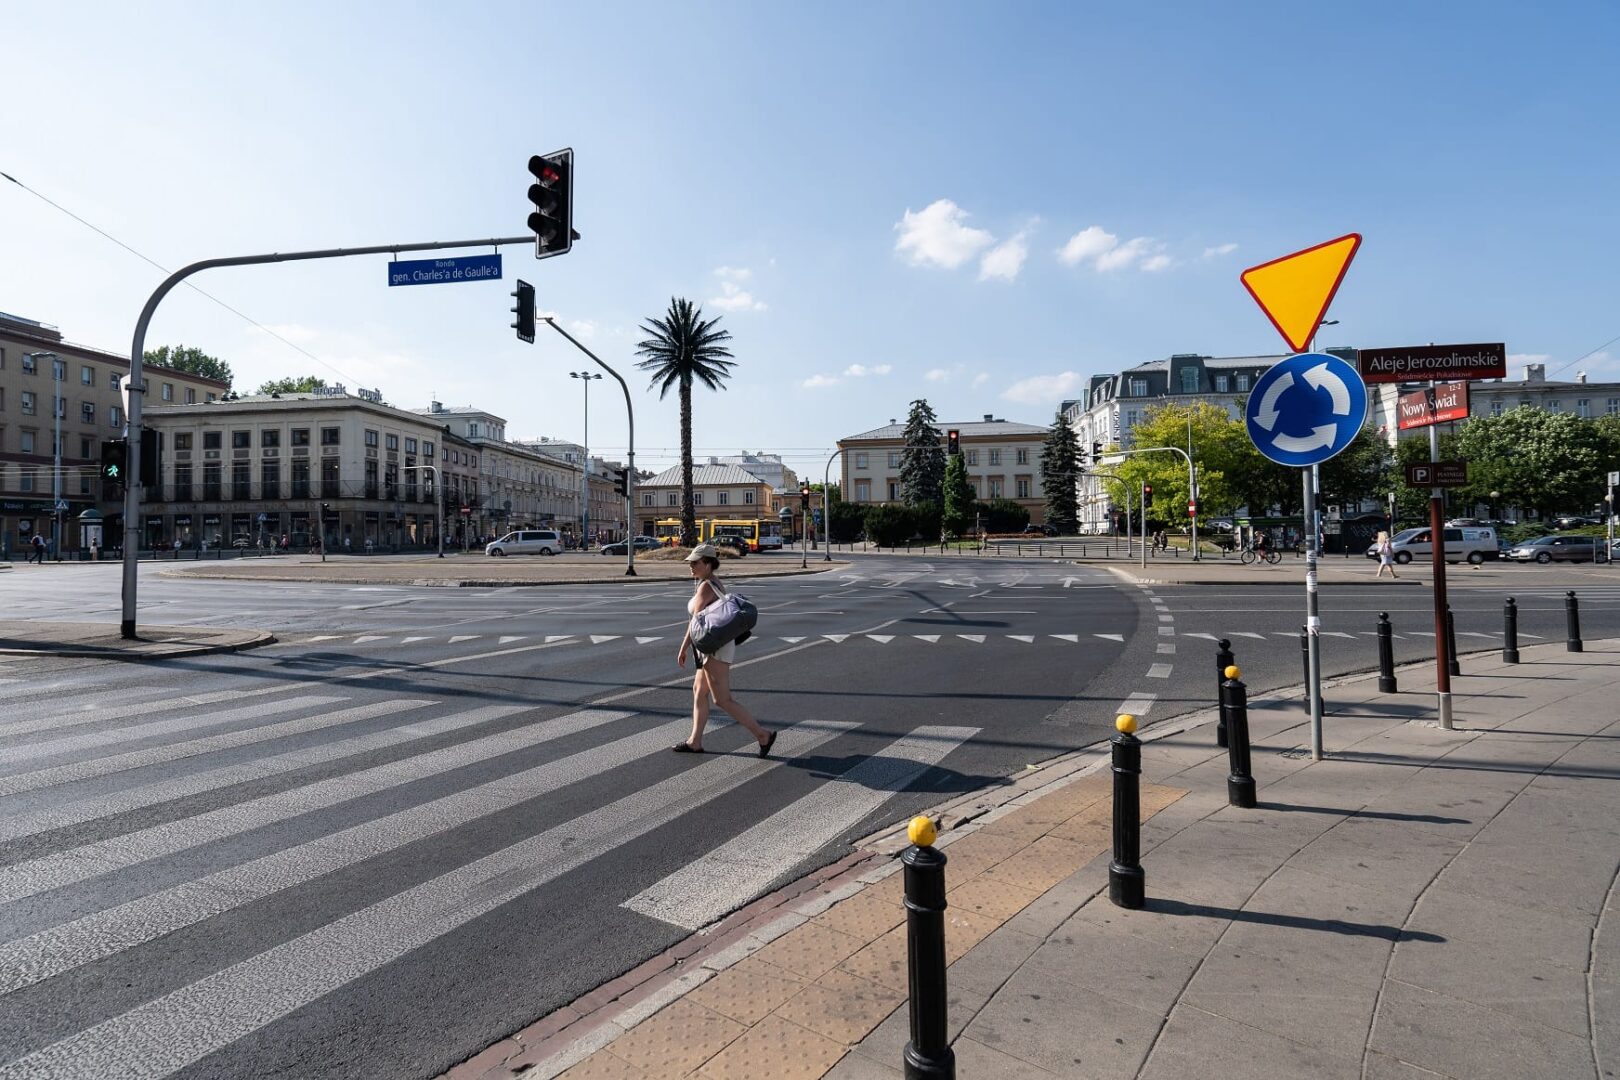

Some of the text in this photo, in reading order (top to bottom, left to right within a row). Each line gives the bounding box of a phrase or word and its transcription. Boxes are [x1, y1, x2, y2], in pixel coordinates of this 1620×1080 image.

[392, 264, 498, 285] gen. Charles'a de Gaulle'a
[435, 260, 456, 268] Rondo
[1369, 351, 1499, 374] Aleje Jerozolimskie
[1402, 393, 1457, 418] Nowy Świat
[1416, 469, 1427, 481] P
